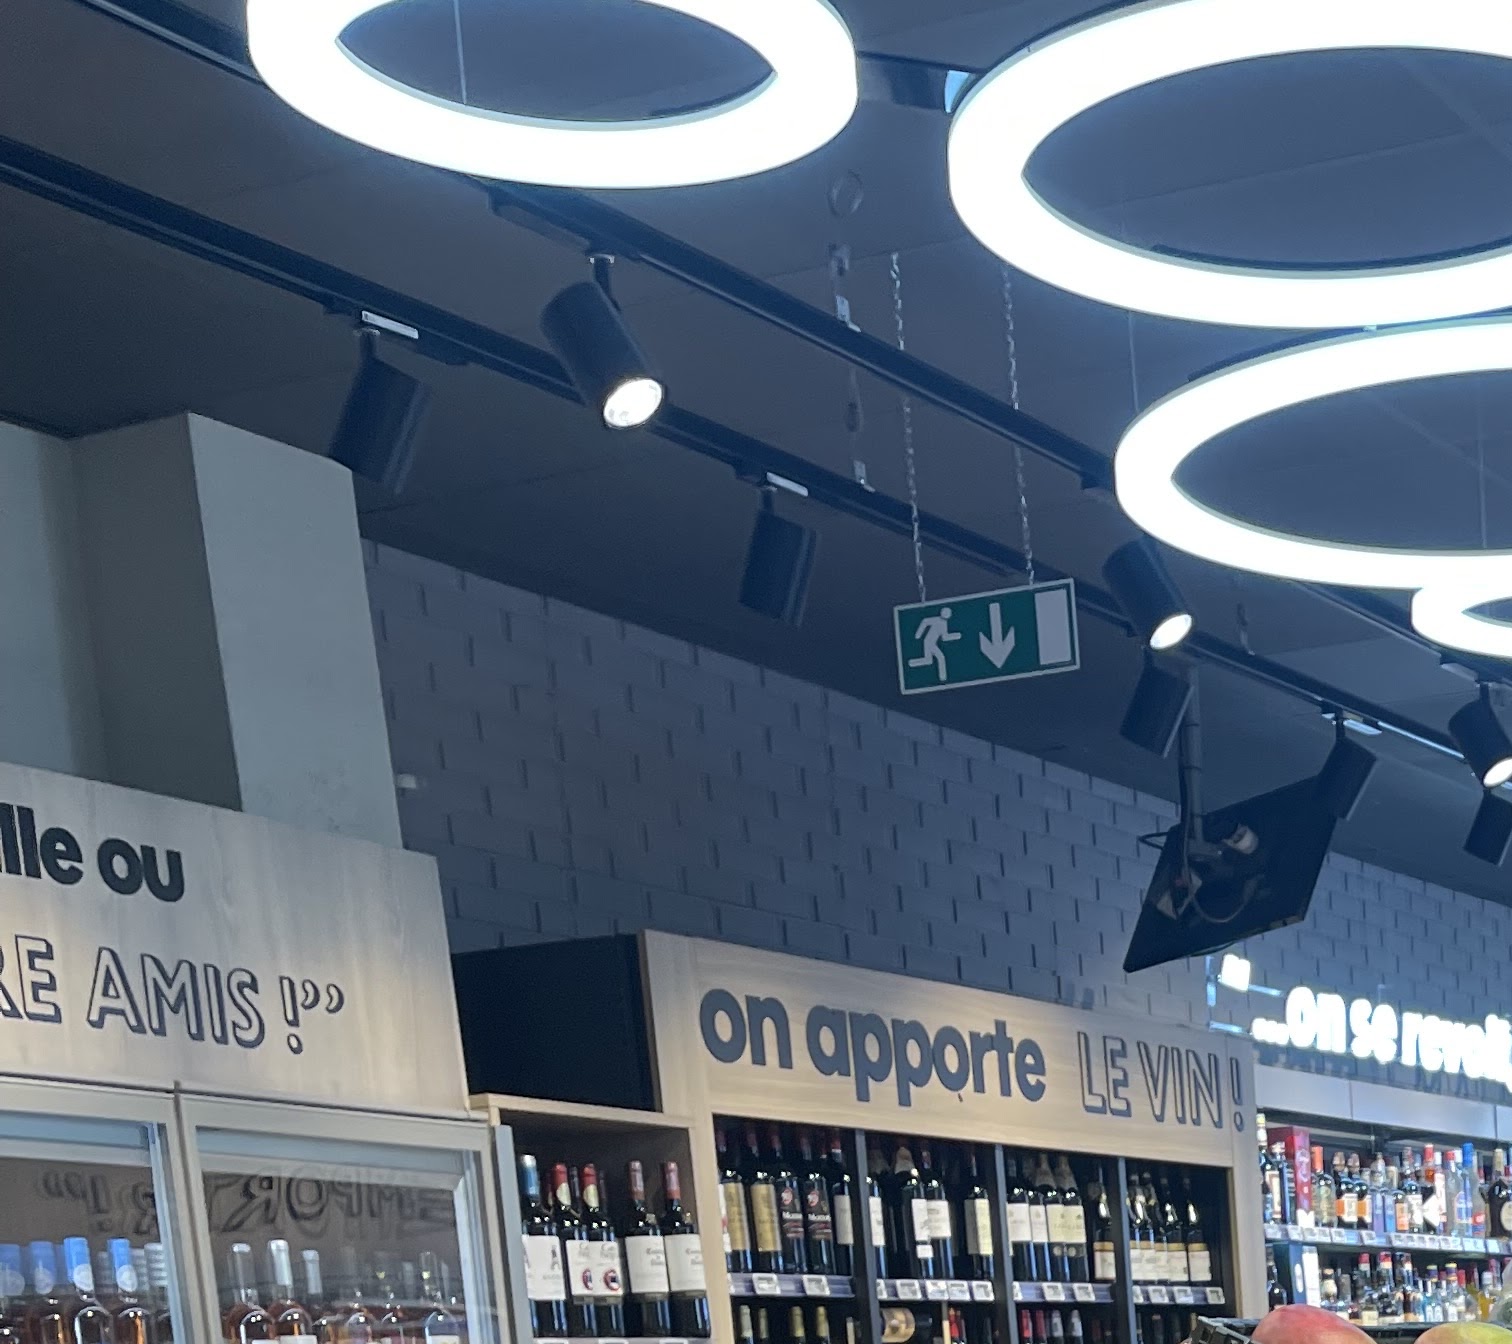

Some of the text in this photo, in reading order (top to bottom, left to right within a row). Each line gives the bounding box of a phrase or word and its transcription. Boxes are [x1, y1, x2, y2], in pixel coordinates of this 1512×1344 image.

[0, 803, 185, 903] lle ou
[86, 946, 266, 1049] AMIS
[1350, 999, 1398, 1064] se
[699, 988, 793, 1070] on
[805, 1005, 1048, 1108] apporte
[1075, 1031, 1132, 1119] LE
[1136, 1039, 1223, 1129] VIN
